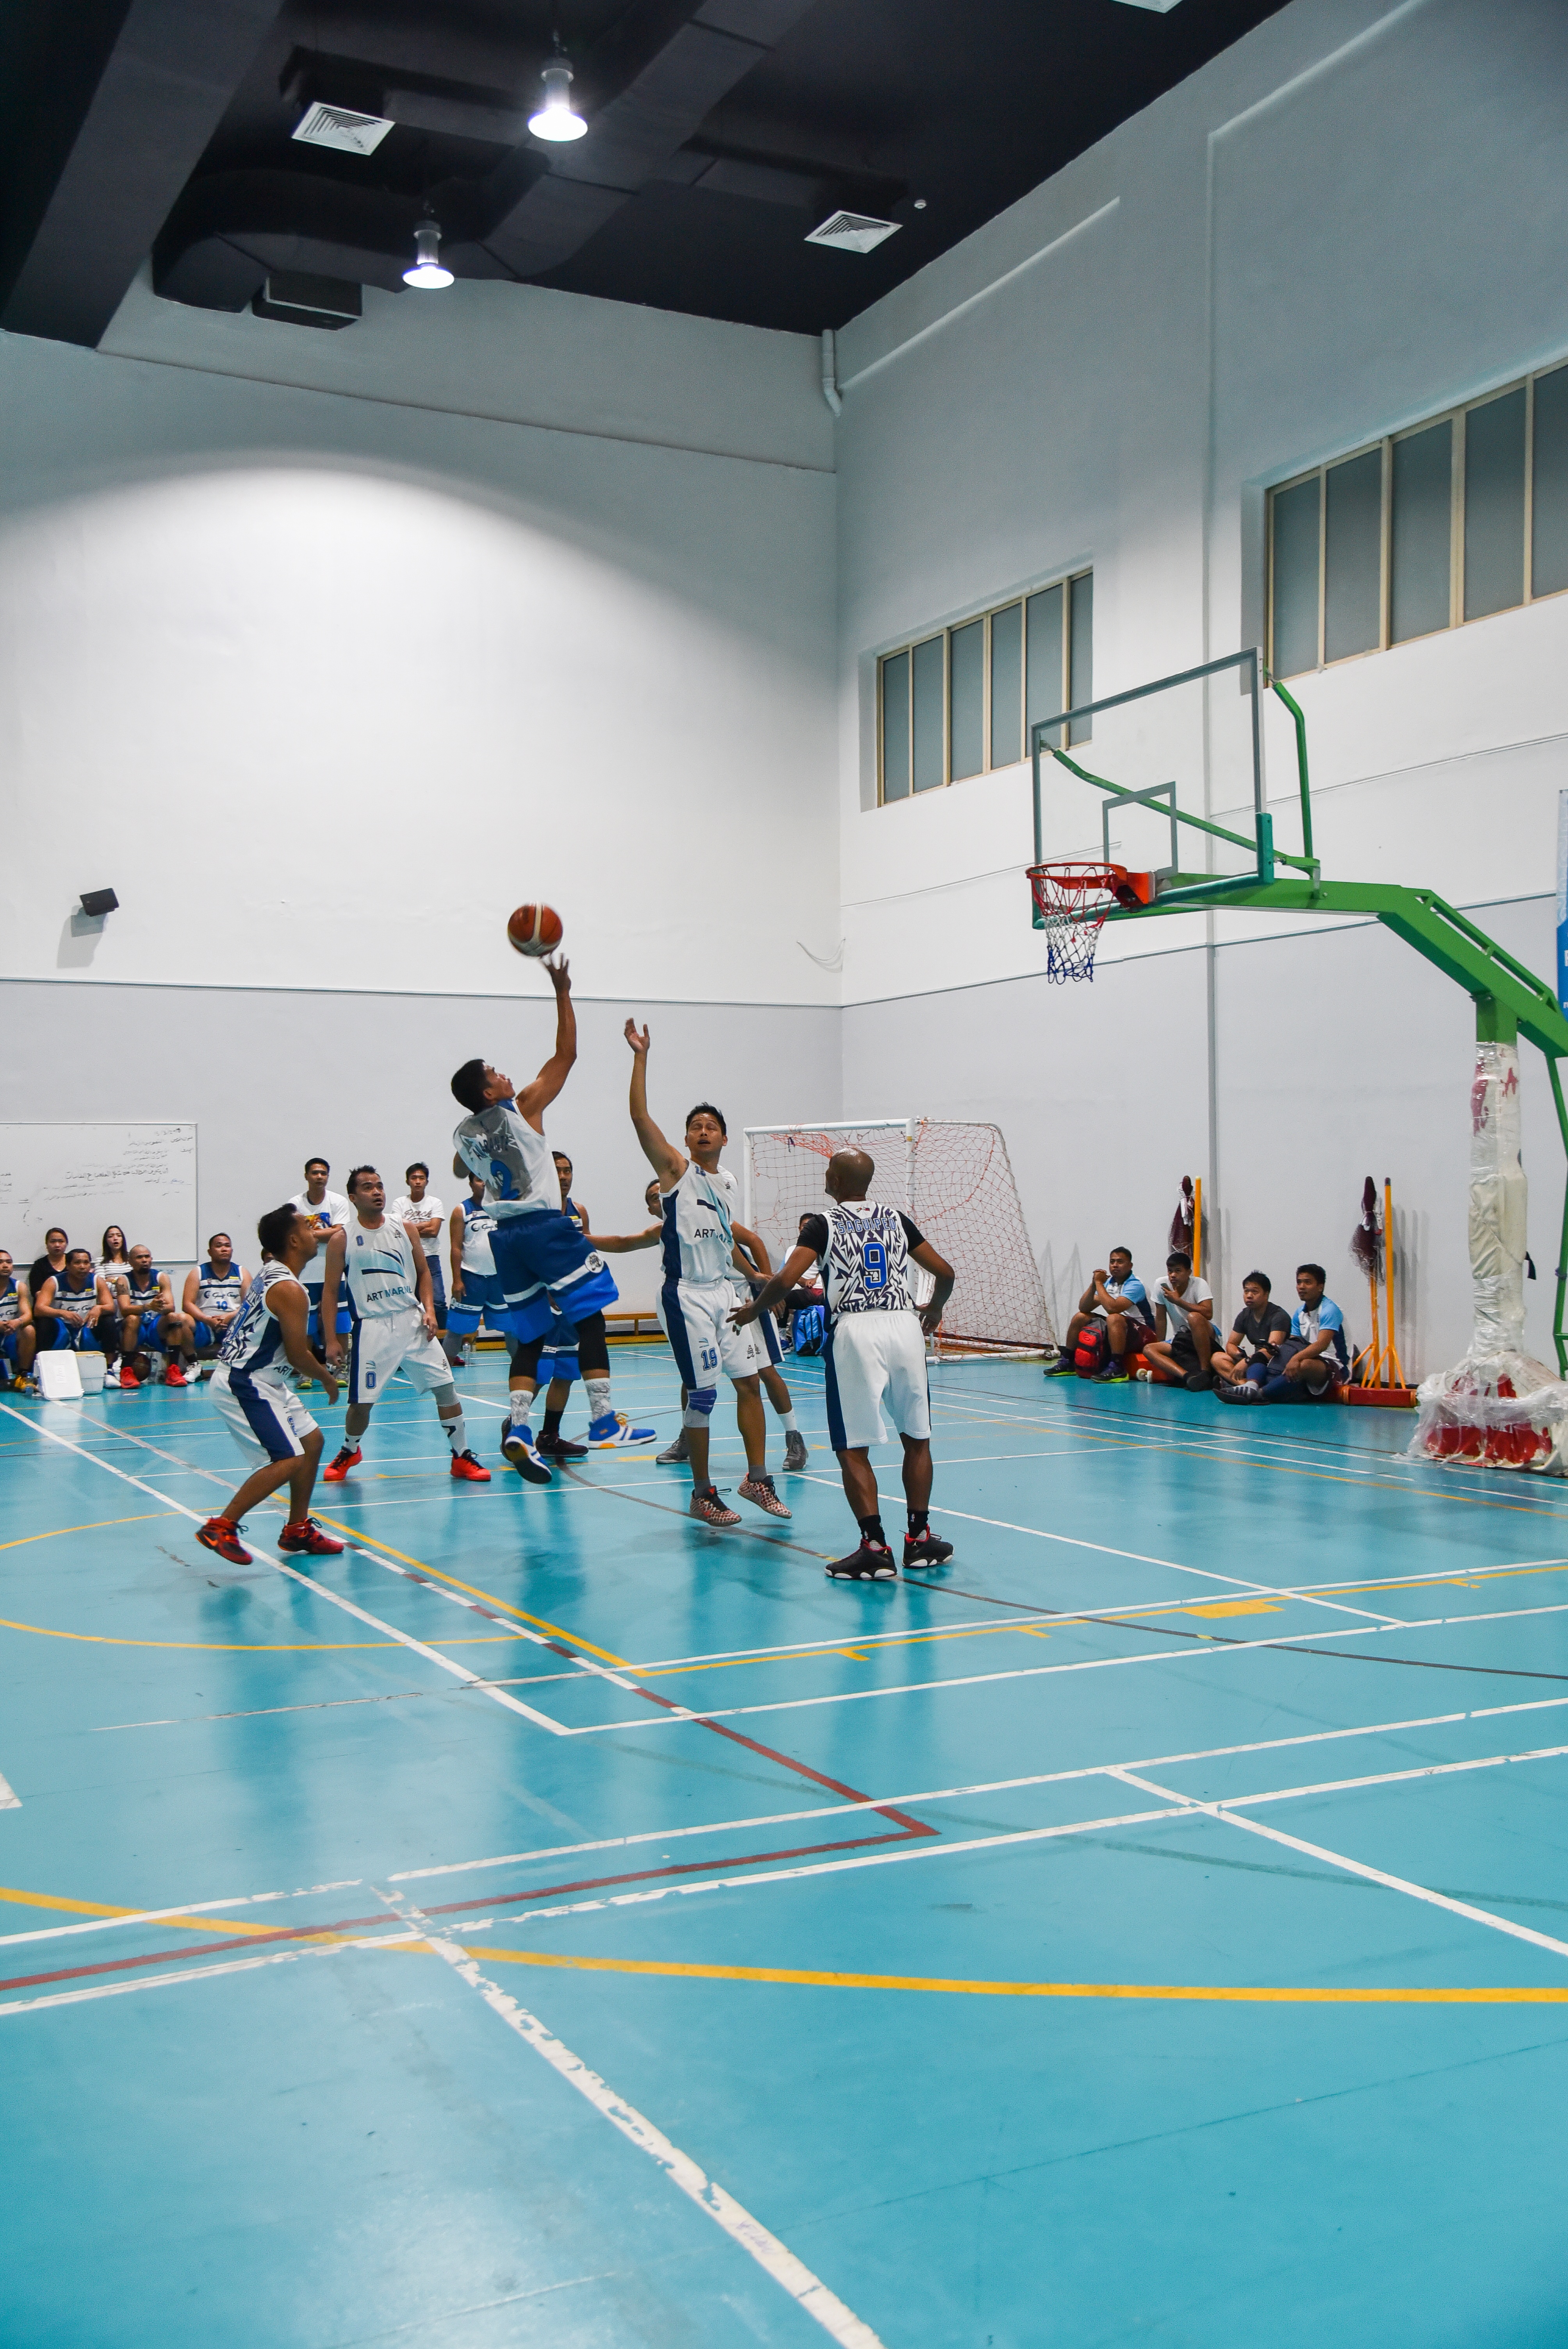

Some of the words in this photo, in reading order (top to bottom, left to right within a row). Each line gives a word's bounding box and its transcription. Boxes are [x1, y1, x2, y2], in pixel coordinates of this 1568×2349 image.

[490, 1160, 519, 1200] 2
[694, 1229, 715, 1238] ART
[837, 1217, 897, 1235] SAGUIPED
[861, 1241, 888, 1291] 9
[216, 1301, 228, 1310] 10
[367, 1290, 383, 1303] ART
[701, 1347, 718, 1371] 19
